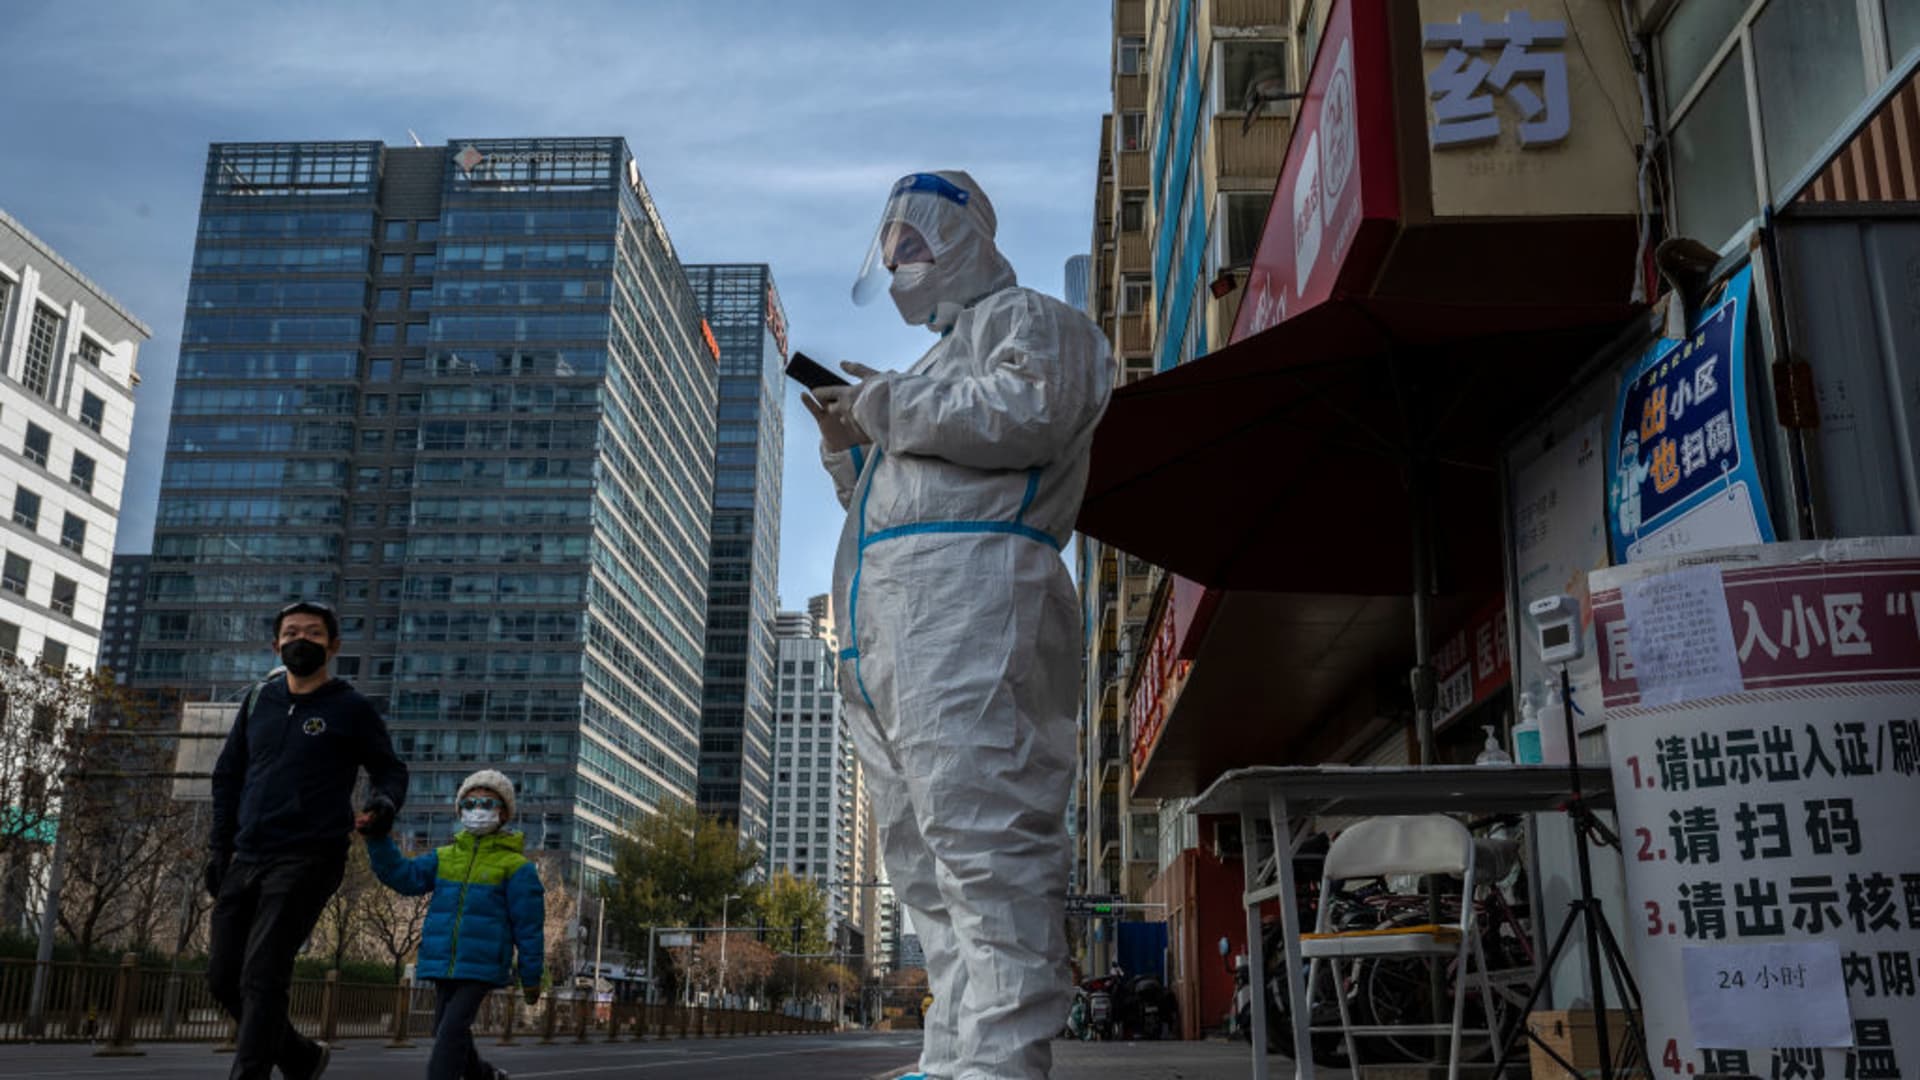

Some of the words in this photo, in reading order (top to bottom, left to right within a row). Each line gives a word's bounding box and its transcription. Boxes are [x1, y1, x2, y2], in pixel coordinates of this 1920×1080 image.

[1423, 11, 1571, 149] 药
[1640, 353, 1719, 443] 出小区
[1649, 409, 1732, 494] 也扫码
[1841, 951, 1920, 998] 内阴
